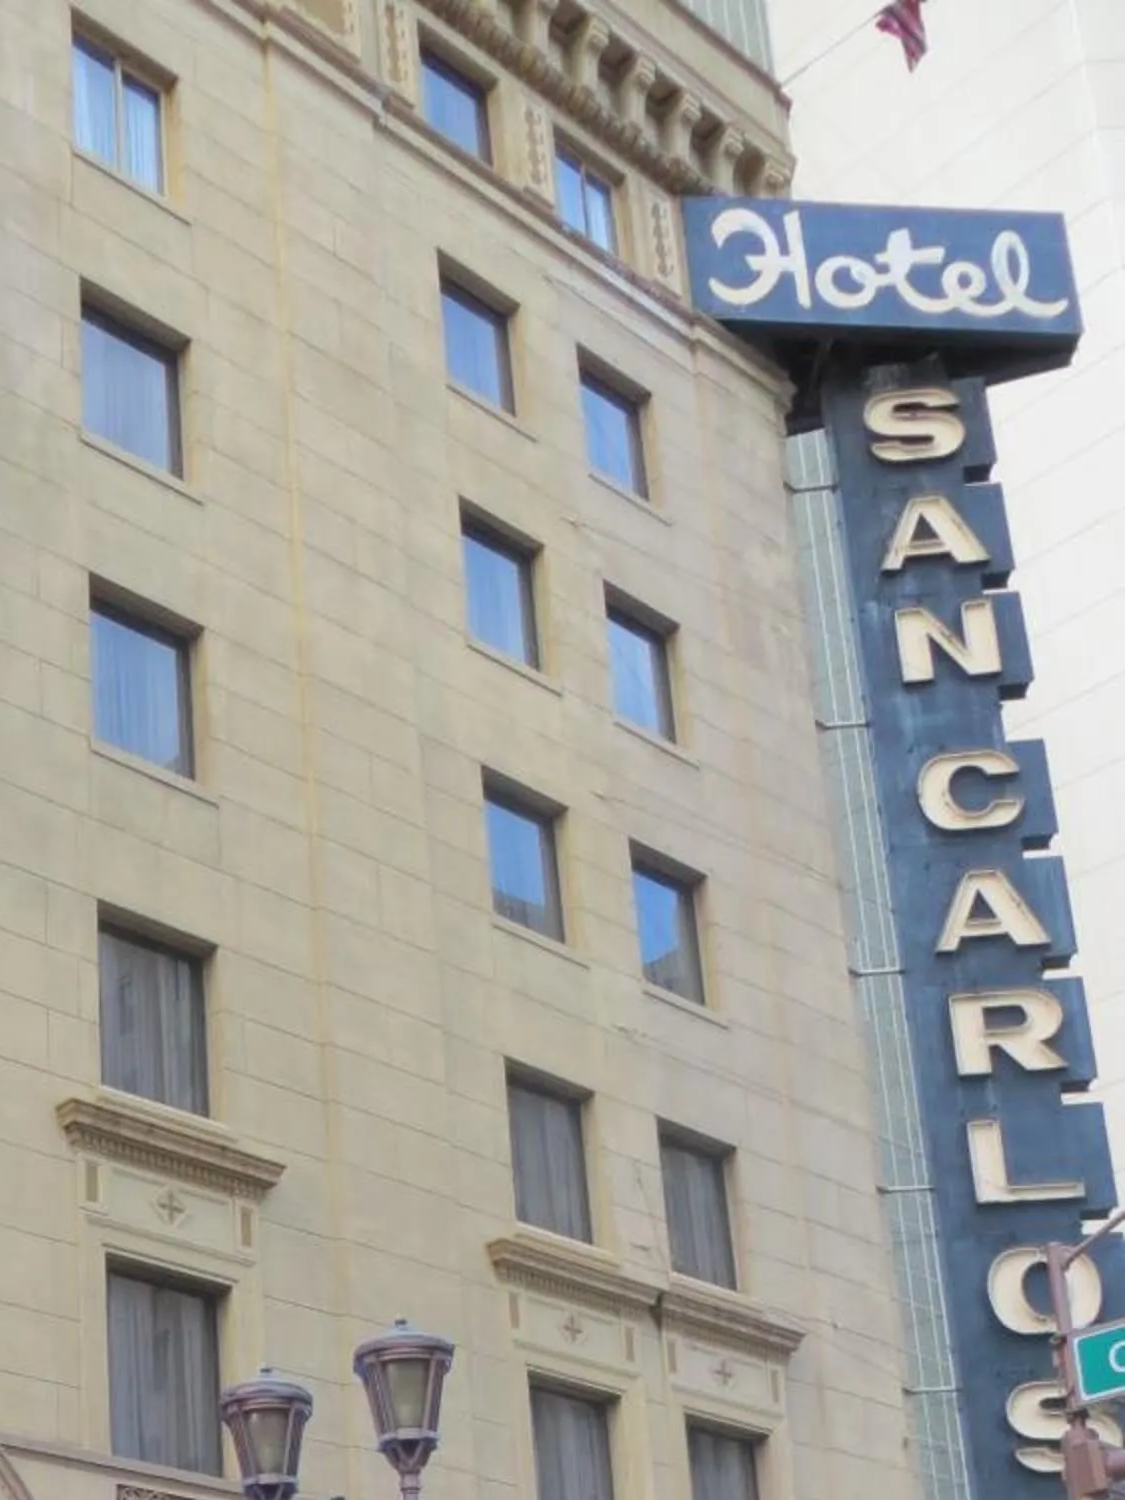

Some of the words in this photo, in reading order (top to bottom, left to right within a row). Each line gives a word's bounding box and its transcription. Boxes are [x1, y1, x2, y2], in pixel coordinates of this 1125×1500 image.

[707, 207, 1069, 318] Hotel
[863, 387, 1003, 684] SAN
[917, 750, 1124, 1473] CARLOS
